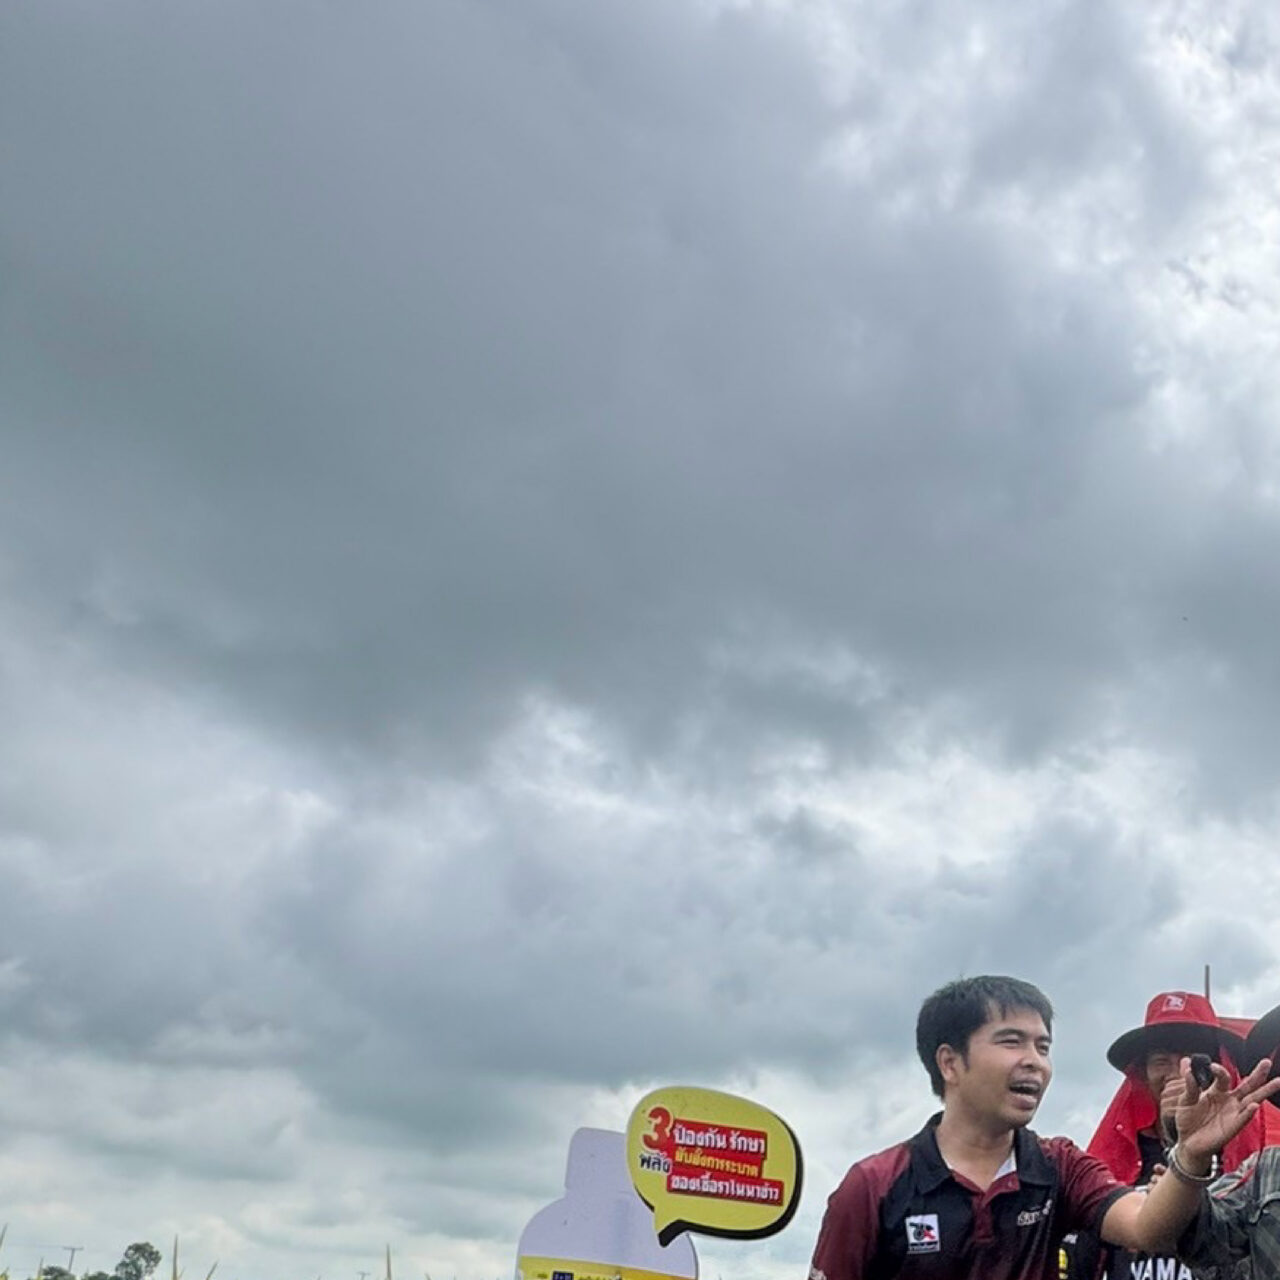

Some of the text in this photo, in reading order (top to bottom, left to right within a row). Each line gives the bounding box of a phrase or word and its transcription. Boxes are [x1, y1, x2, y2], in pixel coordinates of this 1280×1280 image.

[642, 1106, 671, 1150] 3
[673, 1123, 766, 1154] ป้องกัน รักษา
[639, 1150, 671, 1175] พลัง
